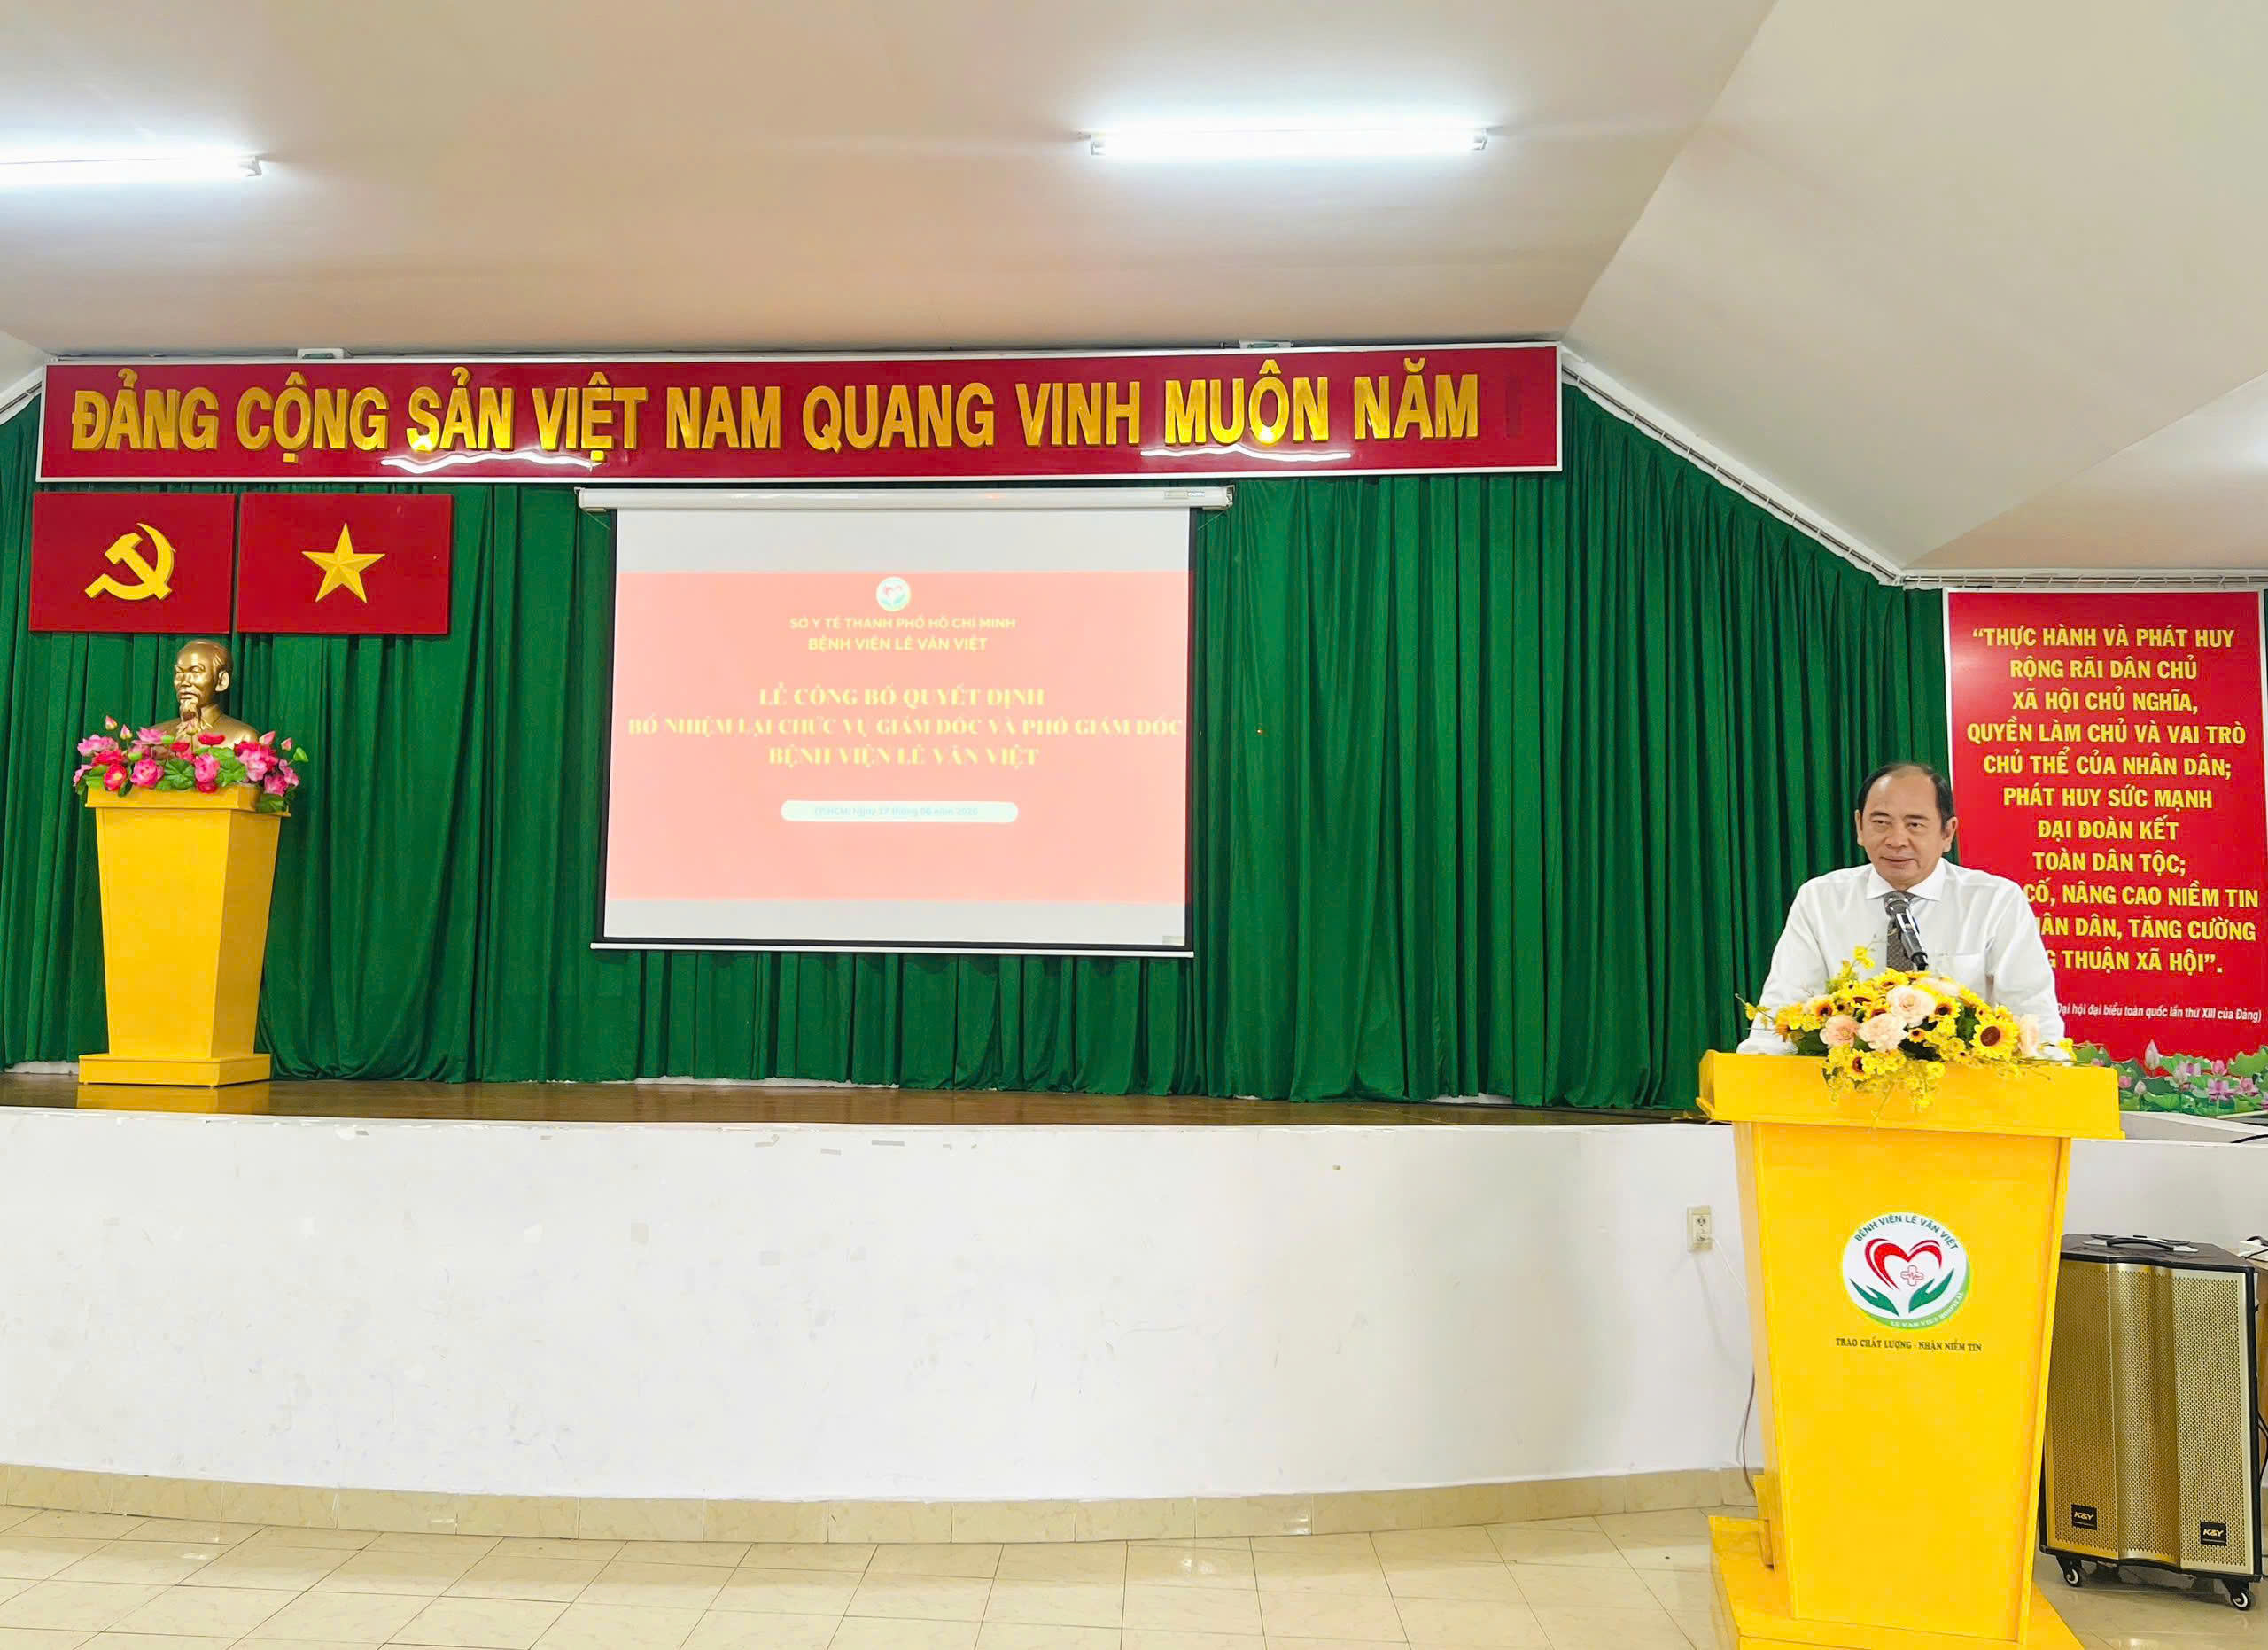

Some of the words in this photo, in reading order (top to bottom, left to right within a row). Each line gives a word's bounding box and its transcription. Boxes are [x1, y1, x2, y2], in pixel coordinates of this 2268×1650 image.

[72, 369, 220, 452] ĐẢNG
[236, 372, 388, 463] CỘNG
[406, 366, 516, 453] SẢN
[531, 372, 647, 463] VIỆT
[666, 385, 781, 450] NAM
[802, 383, 996, 455] QUANG
[1015, 381, 1141, 448] VINH
[1164, 359, 1329, 447] MUÔN
[1353, 358, 1480, 441] NĂM
[1973, 625, 2037, 650] “THỰC
[2043, 624, 2097, 647] HÀNH
[2102, 624, 2129, 647] VÀ
[2136, 624, 2188, 648] PHÁT
[2195, 629, 2235, 648] HUY
[2010, 656, 2064, 681] RỘNG
[2070, 656, 2103, 679] RÃI
[2110, 656, 2151, 679] DÂN
[2157, 654, 2197, 680] CHỦ
[2012, 688, 2038, 710] XÃ
[2045, 688, 2079, 714] HỘI
[2085, 685, 2125, 711] CHỦ
[2132, 689, 2198, 715] NGHĨA,
[1967, 716, 2032, 745] QUYỀN
[2039, 719, 2081, 743] LÀM
[2087, 718, 2127, 743] CHỦ
[2134, 720, 2161, 743] VÀ
[2167, 725, 2200, 744] VAI
[2205, 721, 2247, 745] TRÒ
[1984, 748, 2023, 774] CHỦ
[2030, 746, 2070, 774] THỂ
[2076, 749, 2116, 775] CỦA
[2123, 752, 2178, 776] NHÂN
[2184, 753, 2232, 780] DÂN;
[2003, 783, 2055, 806] PHÁT
[2062, 789, 2101, 807] HUY
[2108, 783, 2148, 807] SỨC
[2155, 789, 2212, 812] MẠNH
[2038, 821, 2071, 843] ĐẠI
[2078, 816, 2133, 840] ĐOÀN
[2140, 815, 2179, 841] KẾT
[2032, 847, 2086, 871] TOÀN
[2093, 848, 2133, 873] DÂN
[2139, 849, 2186, 877] TỘC;
[2023, 877, 2055, 907] CỐ,
[2062, 880, 2117, 905] NÂNG
[2122, 886, 2162, 906] CAO
[2168, 880, 2219, 907] NIỀM
[2225, 889, 2258, 908] TIN
[2075, 913, 2123, 941] DÂN,
[2128, 915, 2182, 939] TĂNG
[2187, 916, 2256, 941] CƯỜNG
[2062, 946, 2130, 974] THUẬN
[2135, 947, 2163, 972] XÃ
[2170, 948, 2224, 976] HỘI”.
[2103, 1001, 2123, 1016] biểu
[2124, 1005, 2144, 1016] toàn
[2146, 1004, 2168, 1019] quốc
[2218, 1007, 2233, 1020] của
[1836, 1337, 1858, 1347] TRAO
[1968, 1343, 1982, 1352] TIN
